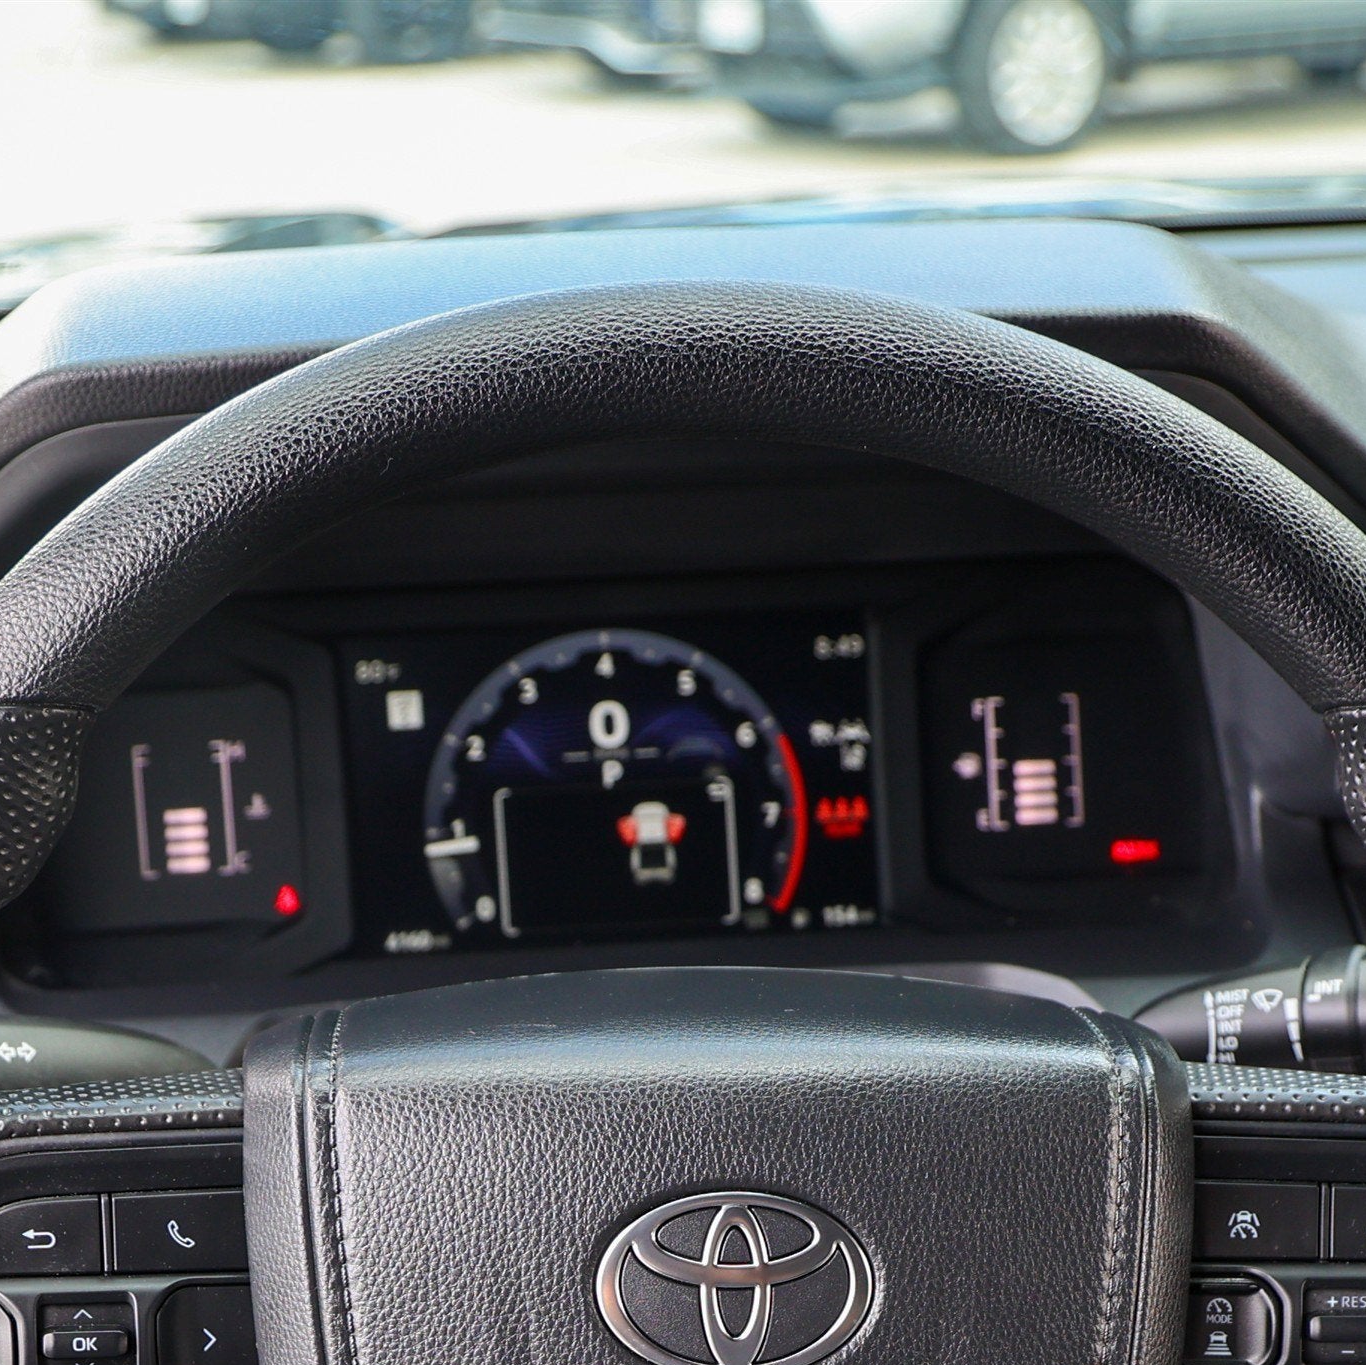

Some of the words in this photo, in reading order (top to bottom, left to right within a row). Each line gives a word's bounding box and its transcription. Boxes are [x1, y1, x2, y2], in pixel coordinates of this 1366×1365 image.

[588, 700, 630, 749] 0
[601, 759, 624, 790] P
[1313, 979, 1343, 995] INT
[1216, 988, 1250, 1005] MIST
[1216, 1004, 1244, 1020] OFF
[1217, 1019, 1243, 1035] INT
[1218, 1035, 1239, 1051] LO
[1206, 1313, 1233, 1325] MODE
[72, 1337, 98, 1352] OK
